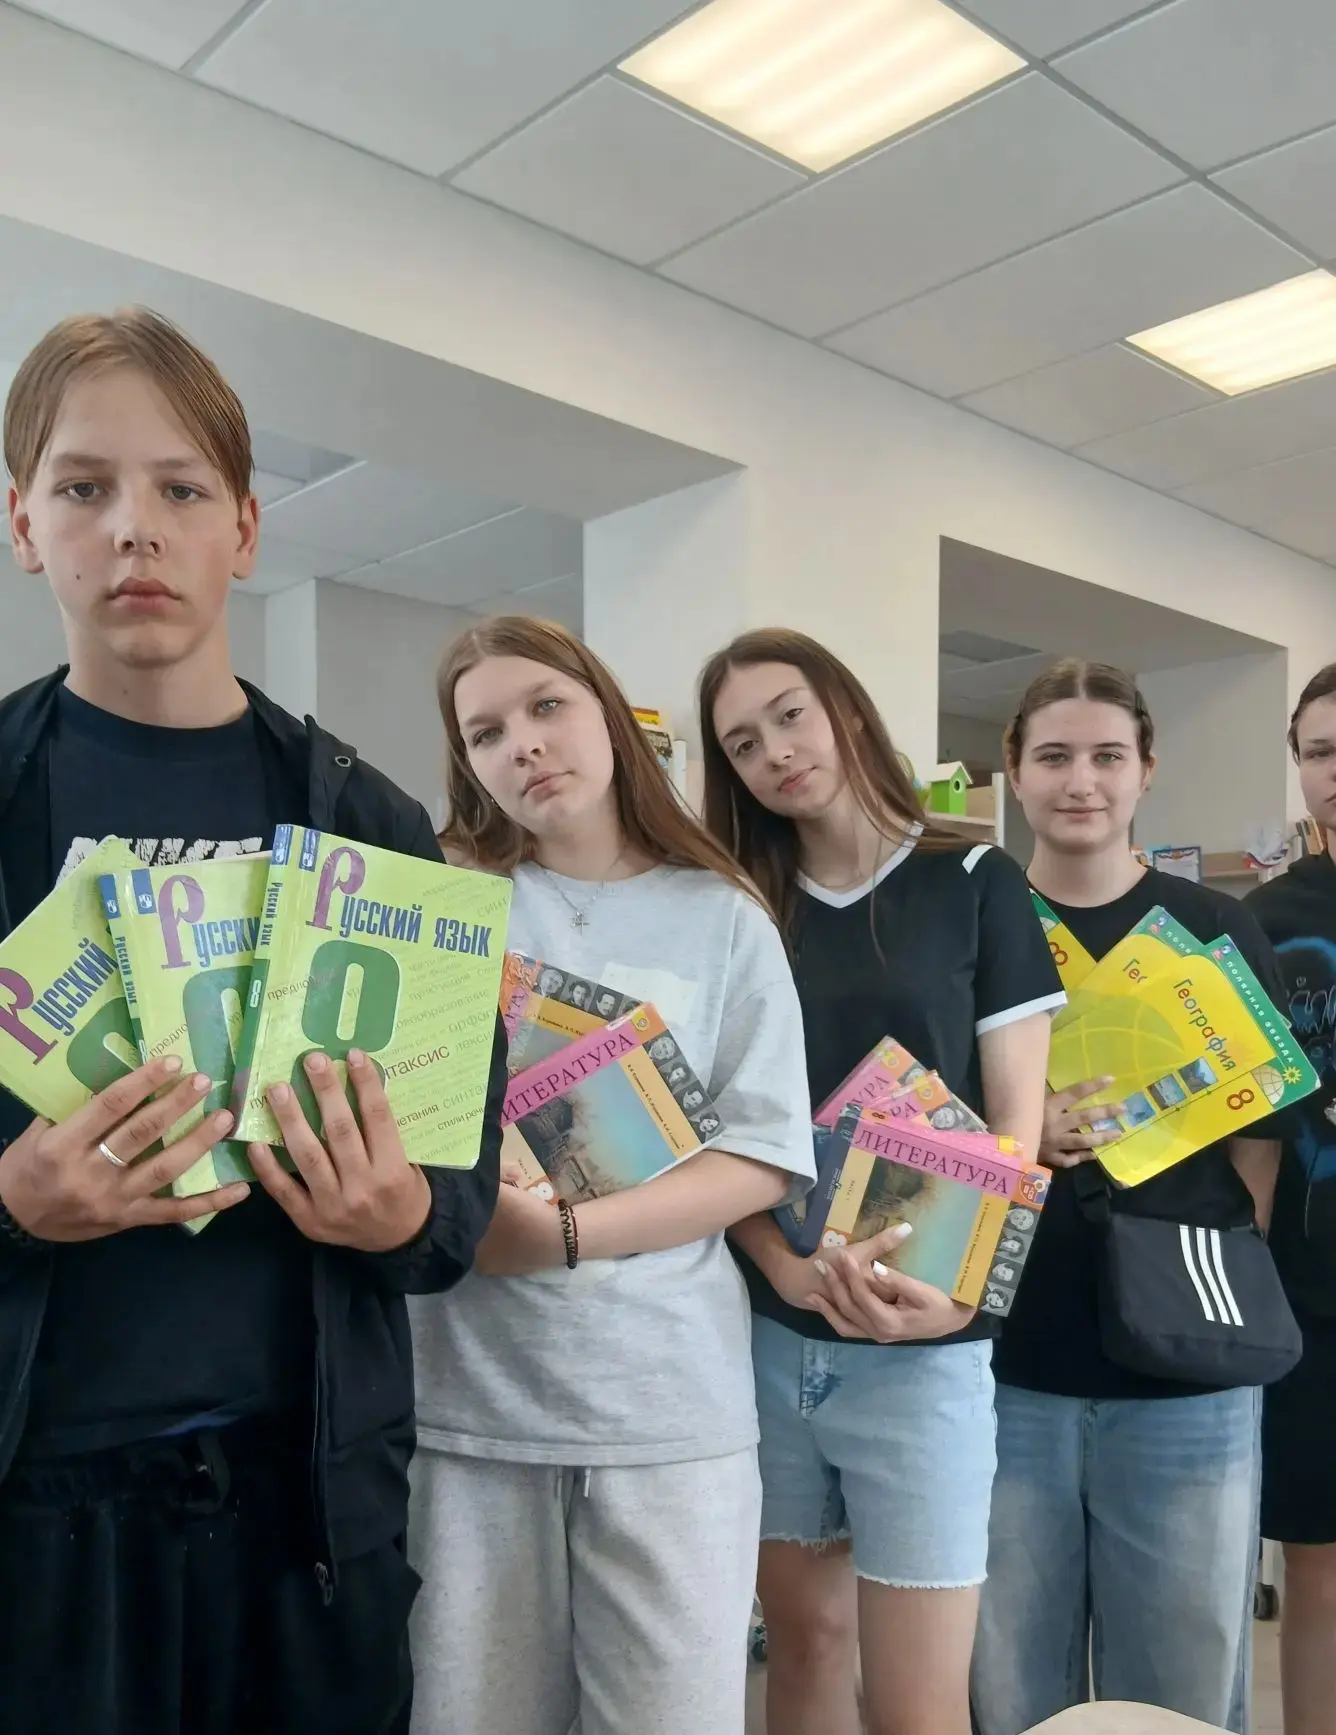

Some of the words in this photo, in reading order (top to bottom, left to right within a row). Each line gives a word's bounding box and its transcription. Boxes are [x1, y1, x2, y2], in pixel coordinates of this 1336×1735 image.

[158, 874, 260, 970] Русски
[305, 846, 422, 943] Русский
[433, 916, 492, 957] язык
[385, 1046, 450, 1080] таксис
[1174, 978, 1237, 1071] География
[502, 1033, 635, 1121] ИТЕРАТУРА
[1226, 1088, 1255, 1110] 8
[855, 1129, 1008, 1194] ЛИТЕРАТУРА
